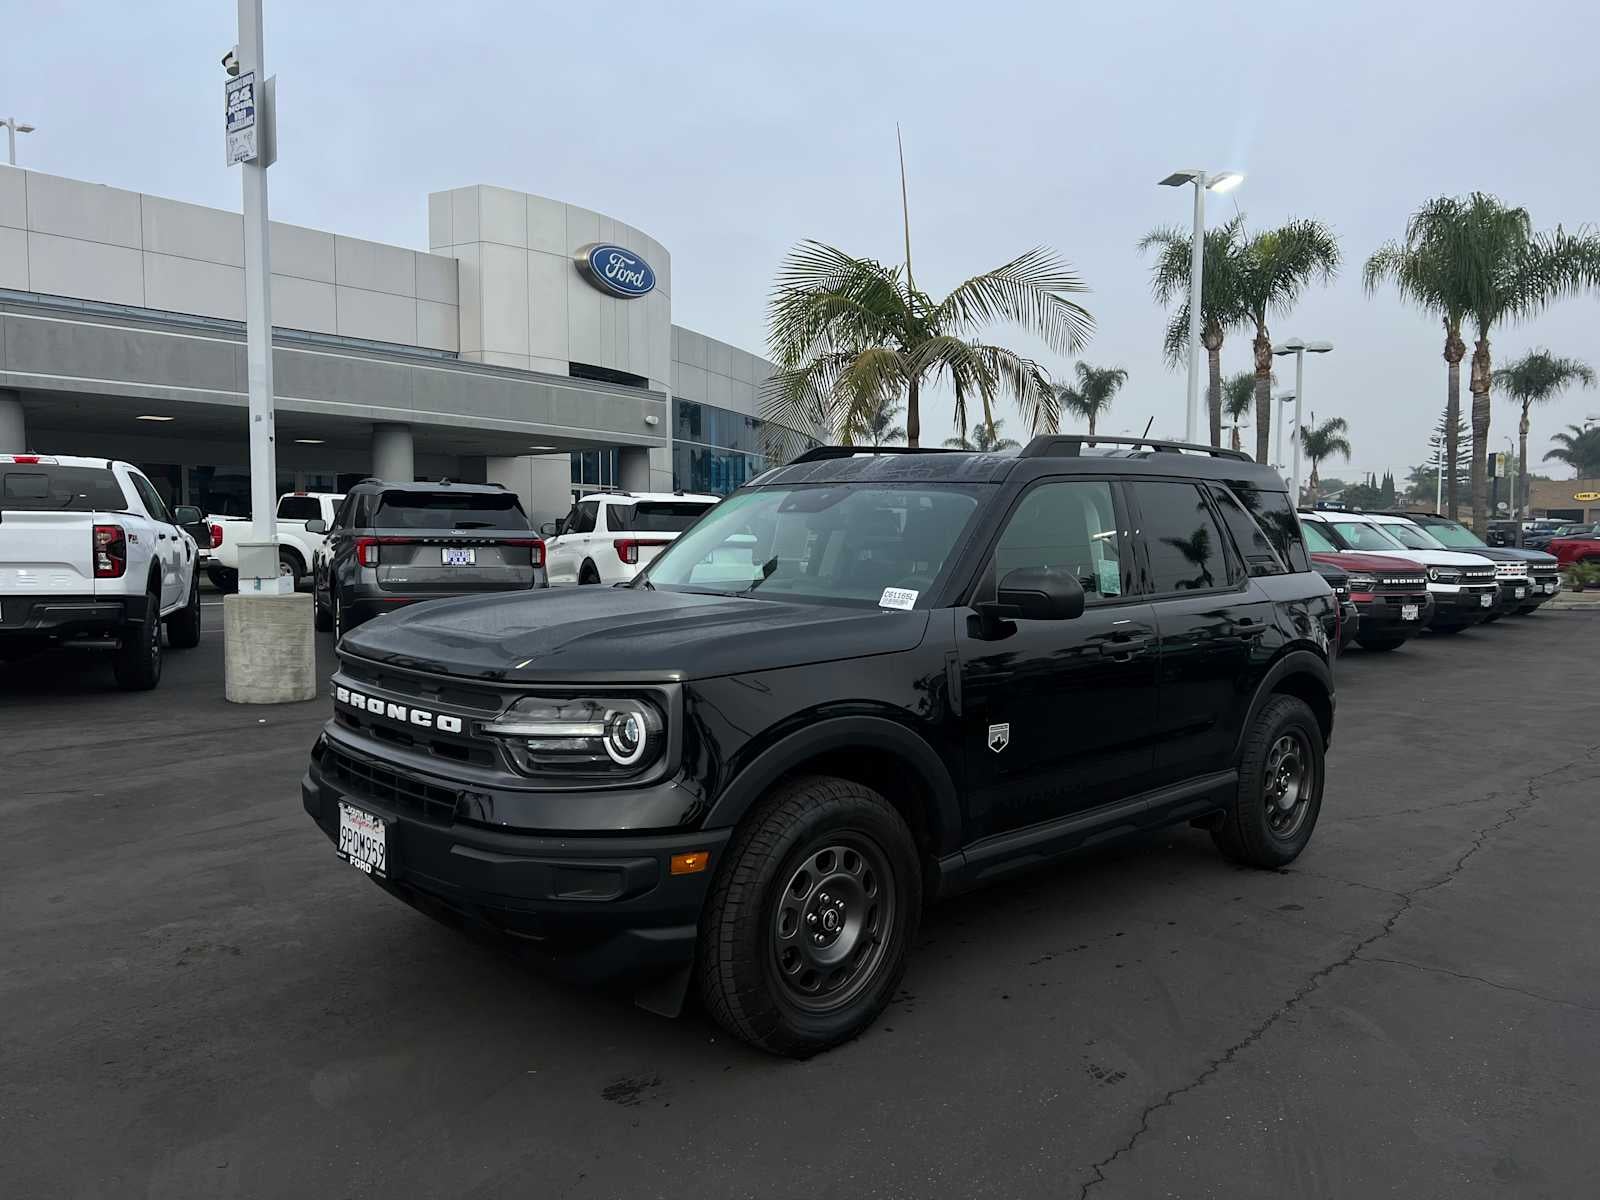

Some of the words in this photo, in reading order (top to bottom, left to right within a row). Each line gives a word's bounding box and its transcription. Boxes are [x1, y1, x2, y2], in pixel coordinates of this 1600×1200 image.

[606, 253, 645, 287] Ford
[336, 687, 462, 733] BRONCO
[350, 855, 372, 874] FORD
